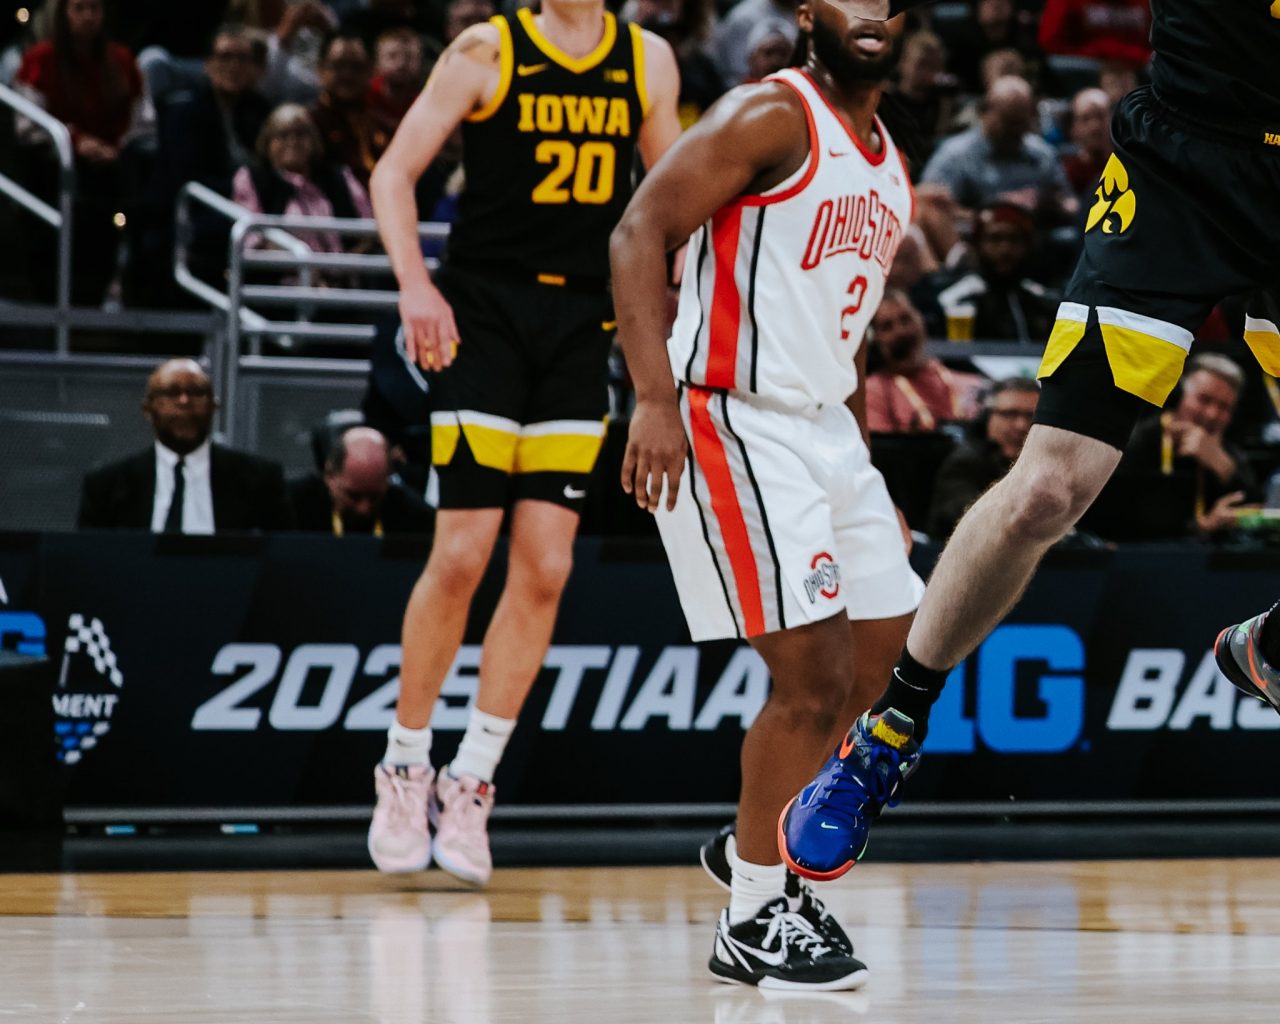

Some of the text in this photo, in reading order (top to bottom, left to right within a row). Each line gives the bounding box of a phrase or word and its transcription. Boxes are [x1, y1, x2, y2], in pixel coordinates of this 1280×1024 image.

[518, 93, 631, 137] IOWA
[532, 140, 616, 204] 20
[801, 189, 902, 277] OHIO STA
[840, 275, 868, 340] 2
[190, 642, 484, 731] 2025
[539, 645, 772, 731] TIAA
